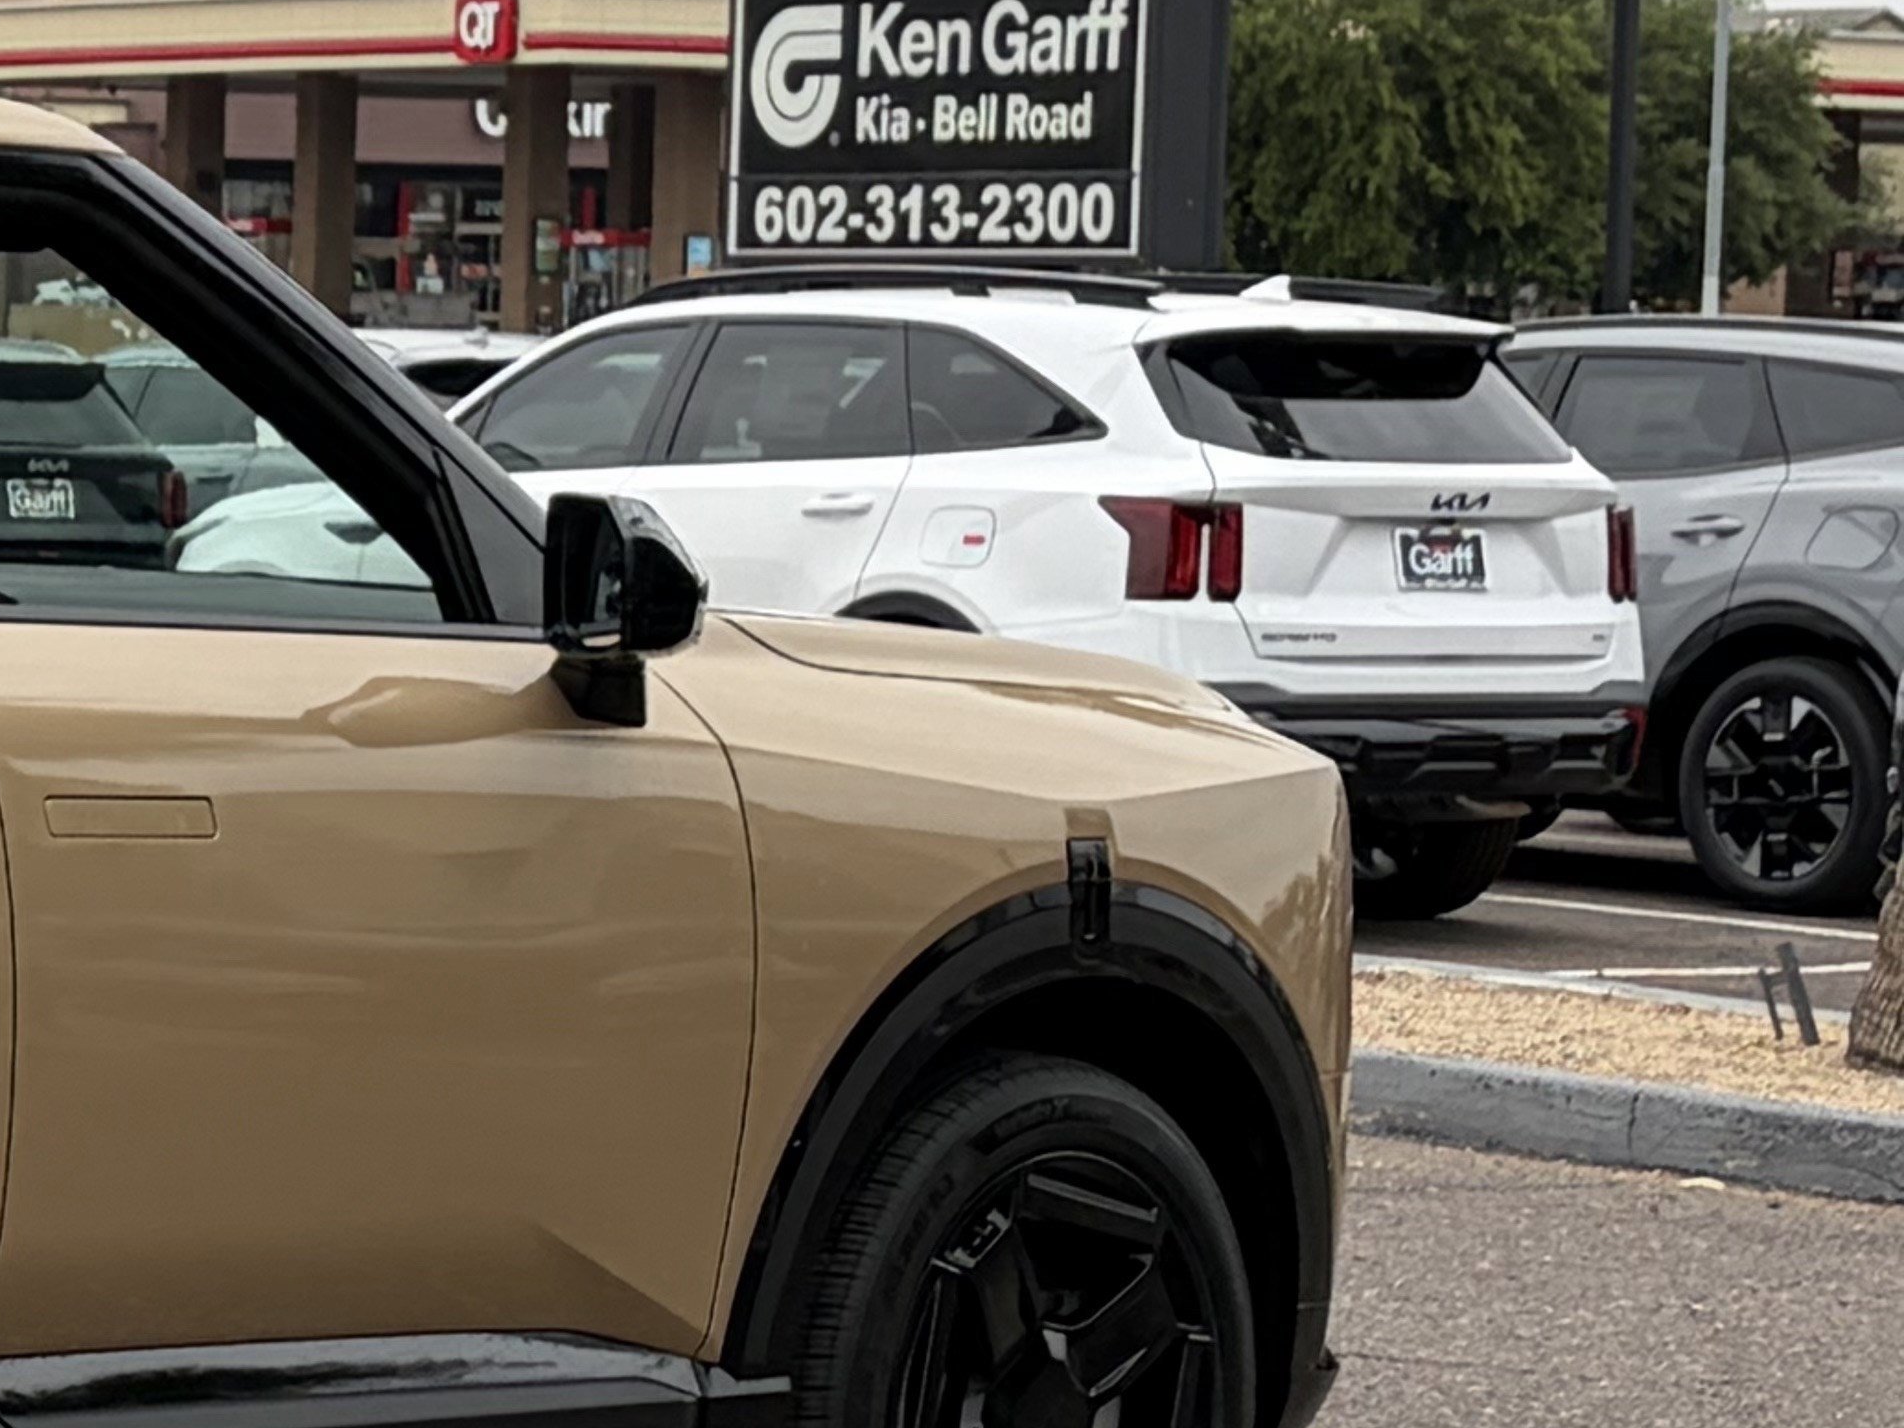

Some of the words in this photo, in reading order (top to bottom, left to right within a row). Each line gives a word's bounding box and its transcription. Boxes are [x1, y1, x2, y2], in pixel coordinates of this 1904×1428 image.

[459, 0, 501, 50] QT
[856, 0, 972, 79] Ken
[855, 92, 911, 144] Kia
[932, 92, 999, 143] Bell
[1005, 90, 1093, 142] Road
[753, 181, 1115, 245] 602-313-2300
[1408, 542, 1474, 575] Garff
